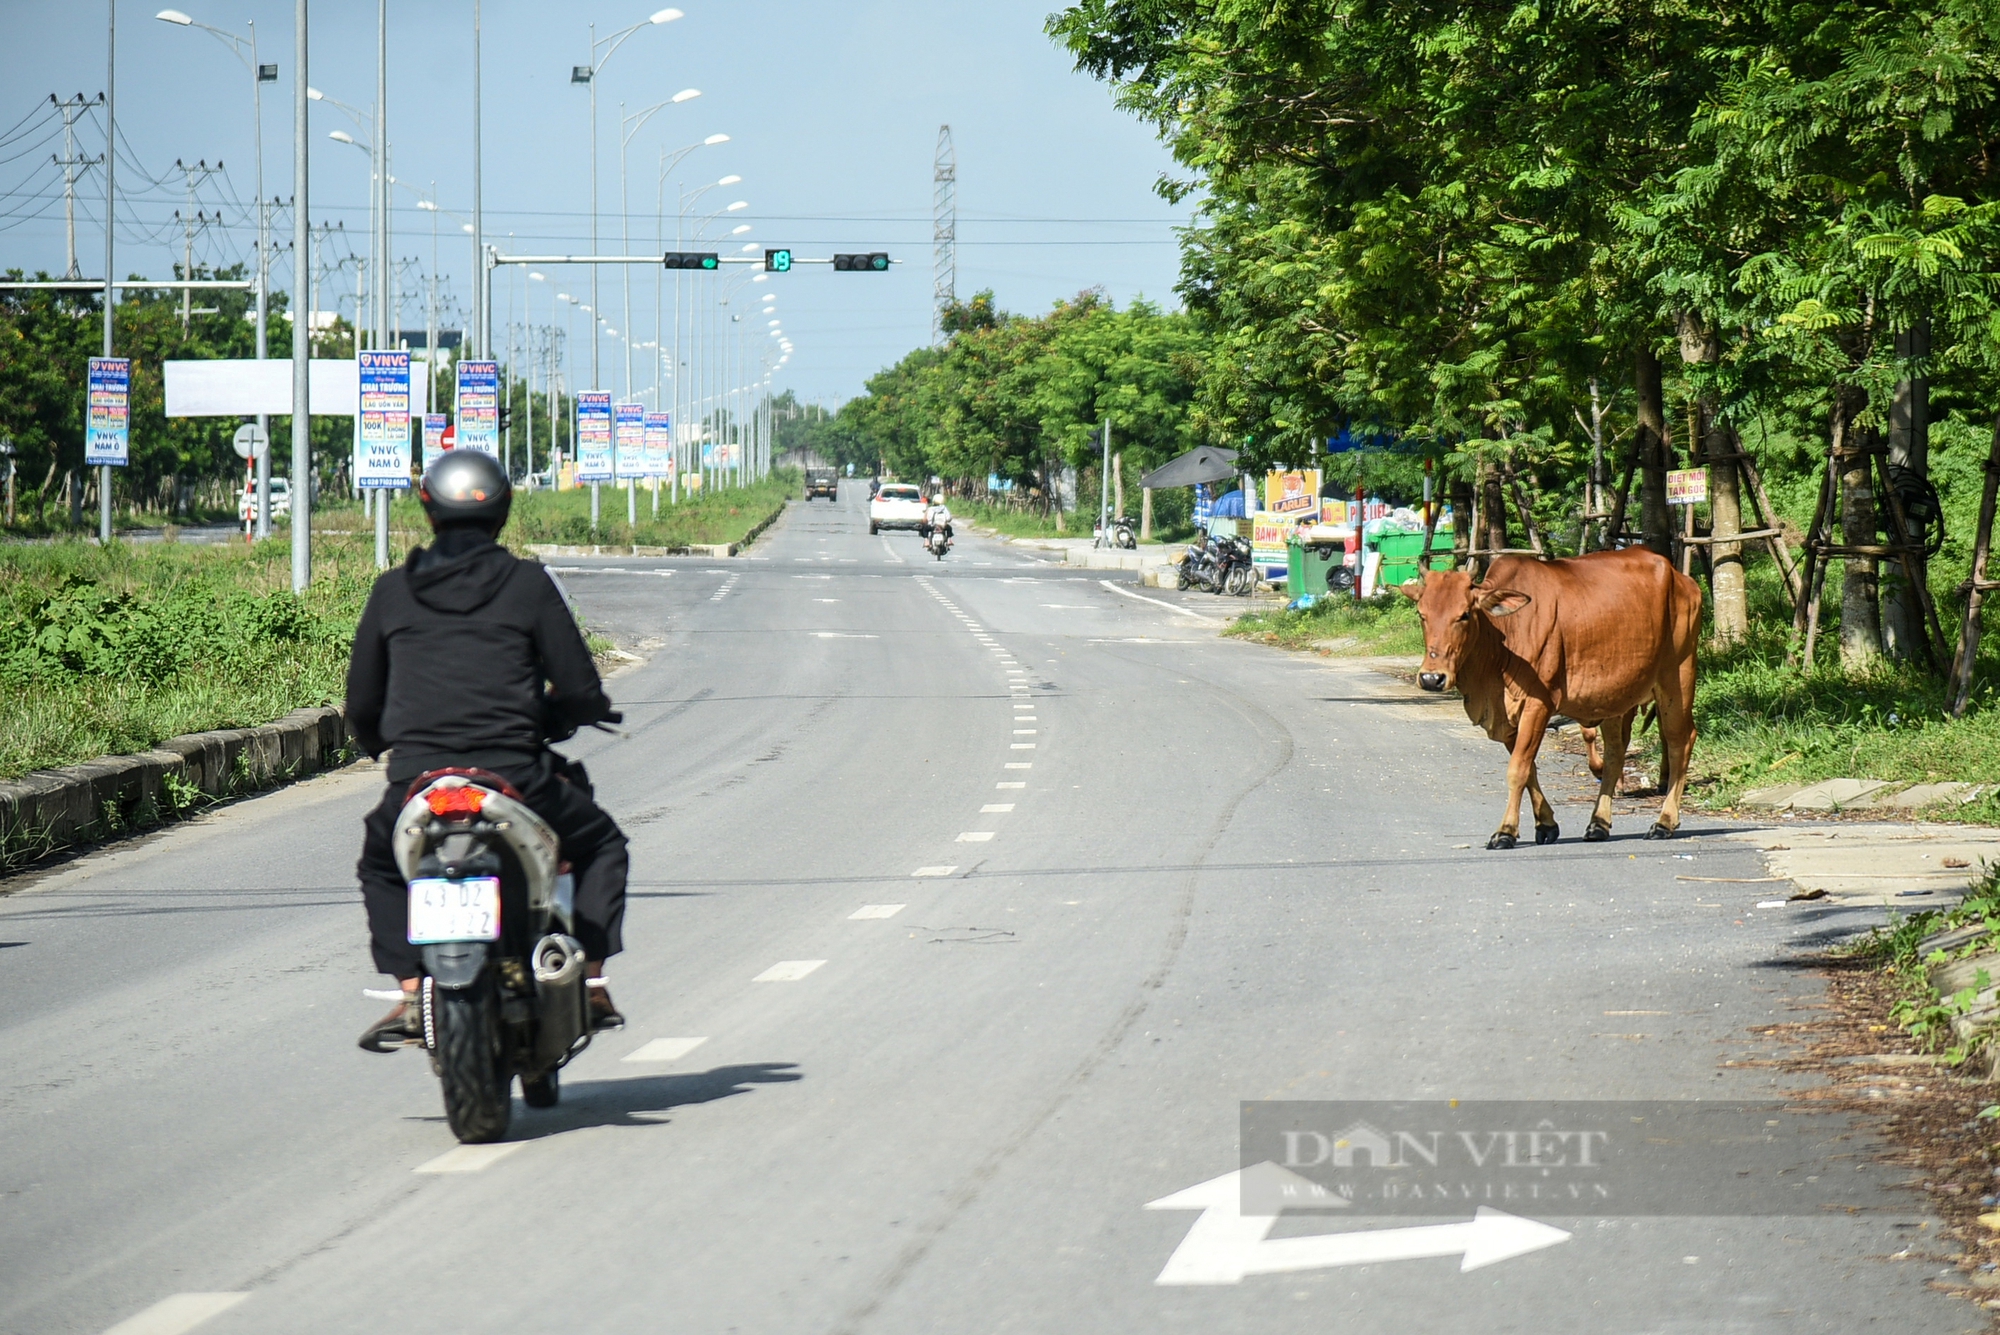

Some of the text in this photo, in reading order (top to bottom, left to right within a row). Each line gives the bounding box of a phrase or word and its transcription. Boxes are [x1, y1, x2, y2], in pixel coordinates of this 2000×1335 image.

[773, 251, 789, 270] 19
[373, 355, 408, 367] VNVC
[100, 362, 128, 371] VNVC
[469, 364, 495, 373] VNVC
[361, 383, 379, 392] KHAI
[364, 421, 382, 430] 100K
[97, 431, 118, 440] VNVC
[467, 433, 488, 442] VNVC
[94, 442, 113, 451] NAM
[371, 445, 398, 455] VNVC
[369, 457, 401, 468] NAM Ô
[1275, 496, 1310, 512] LARUE
